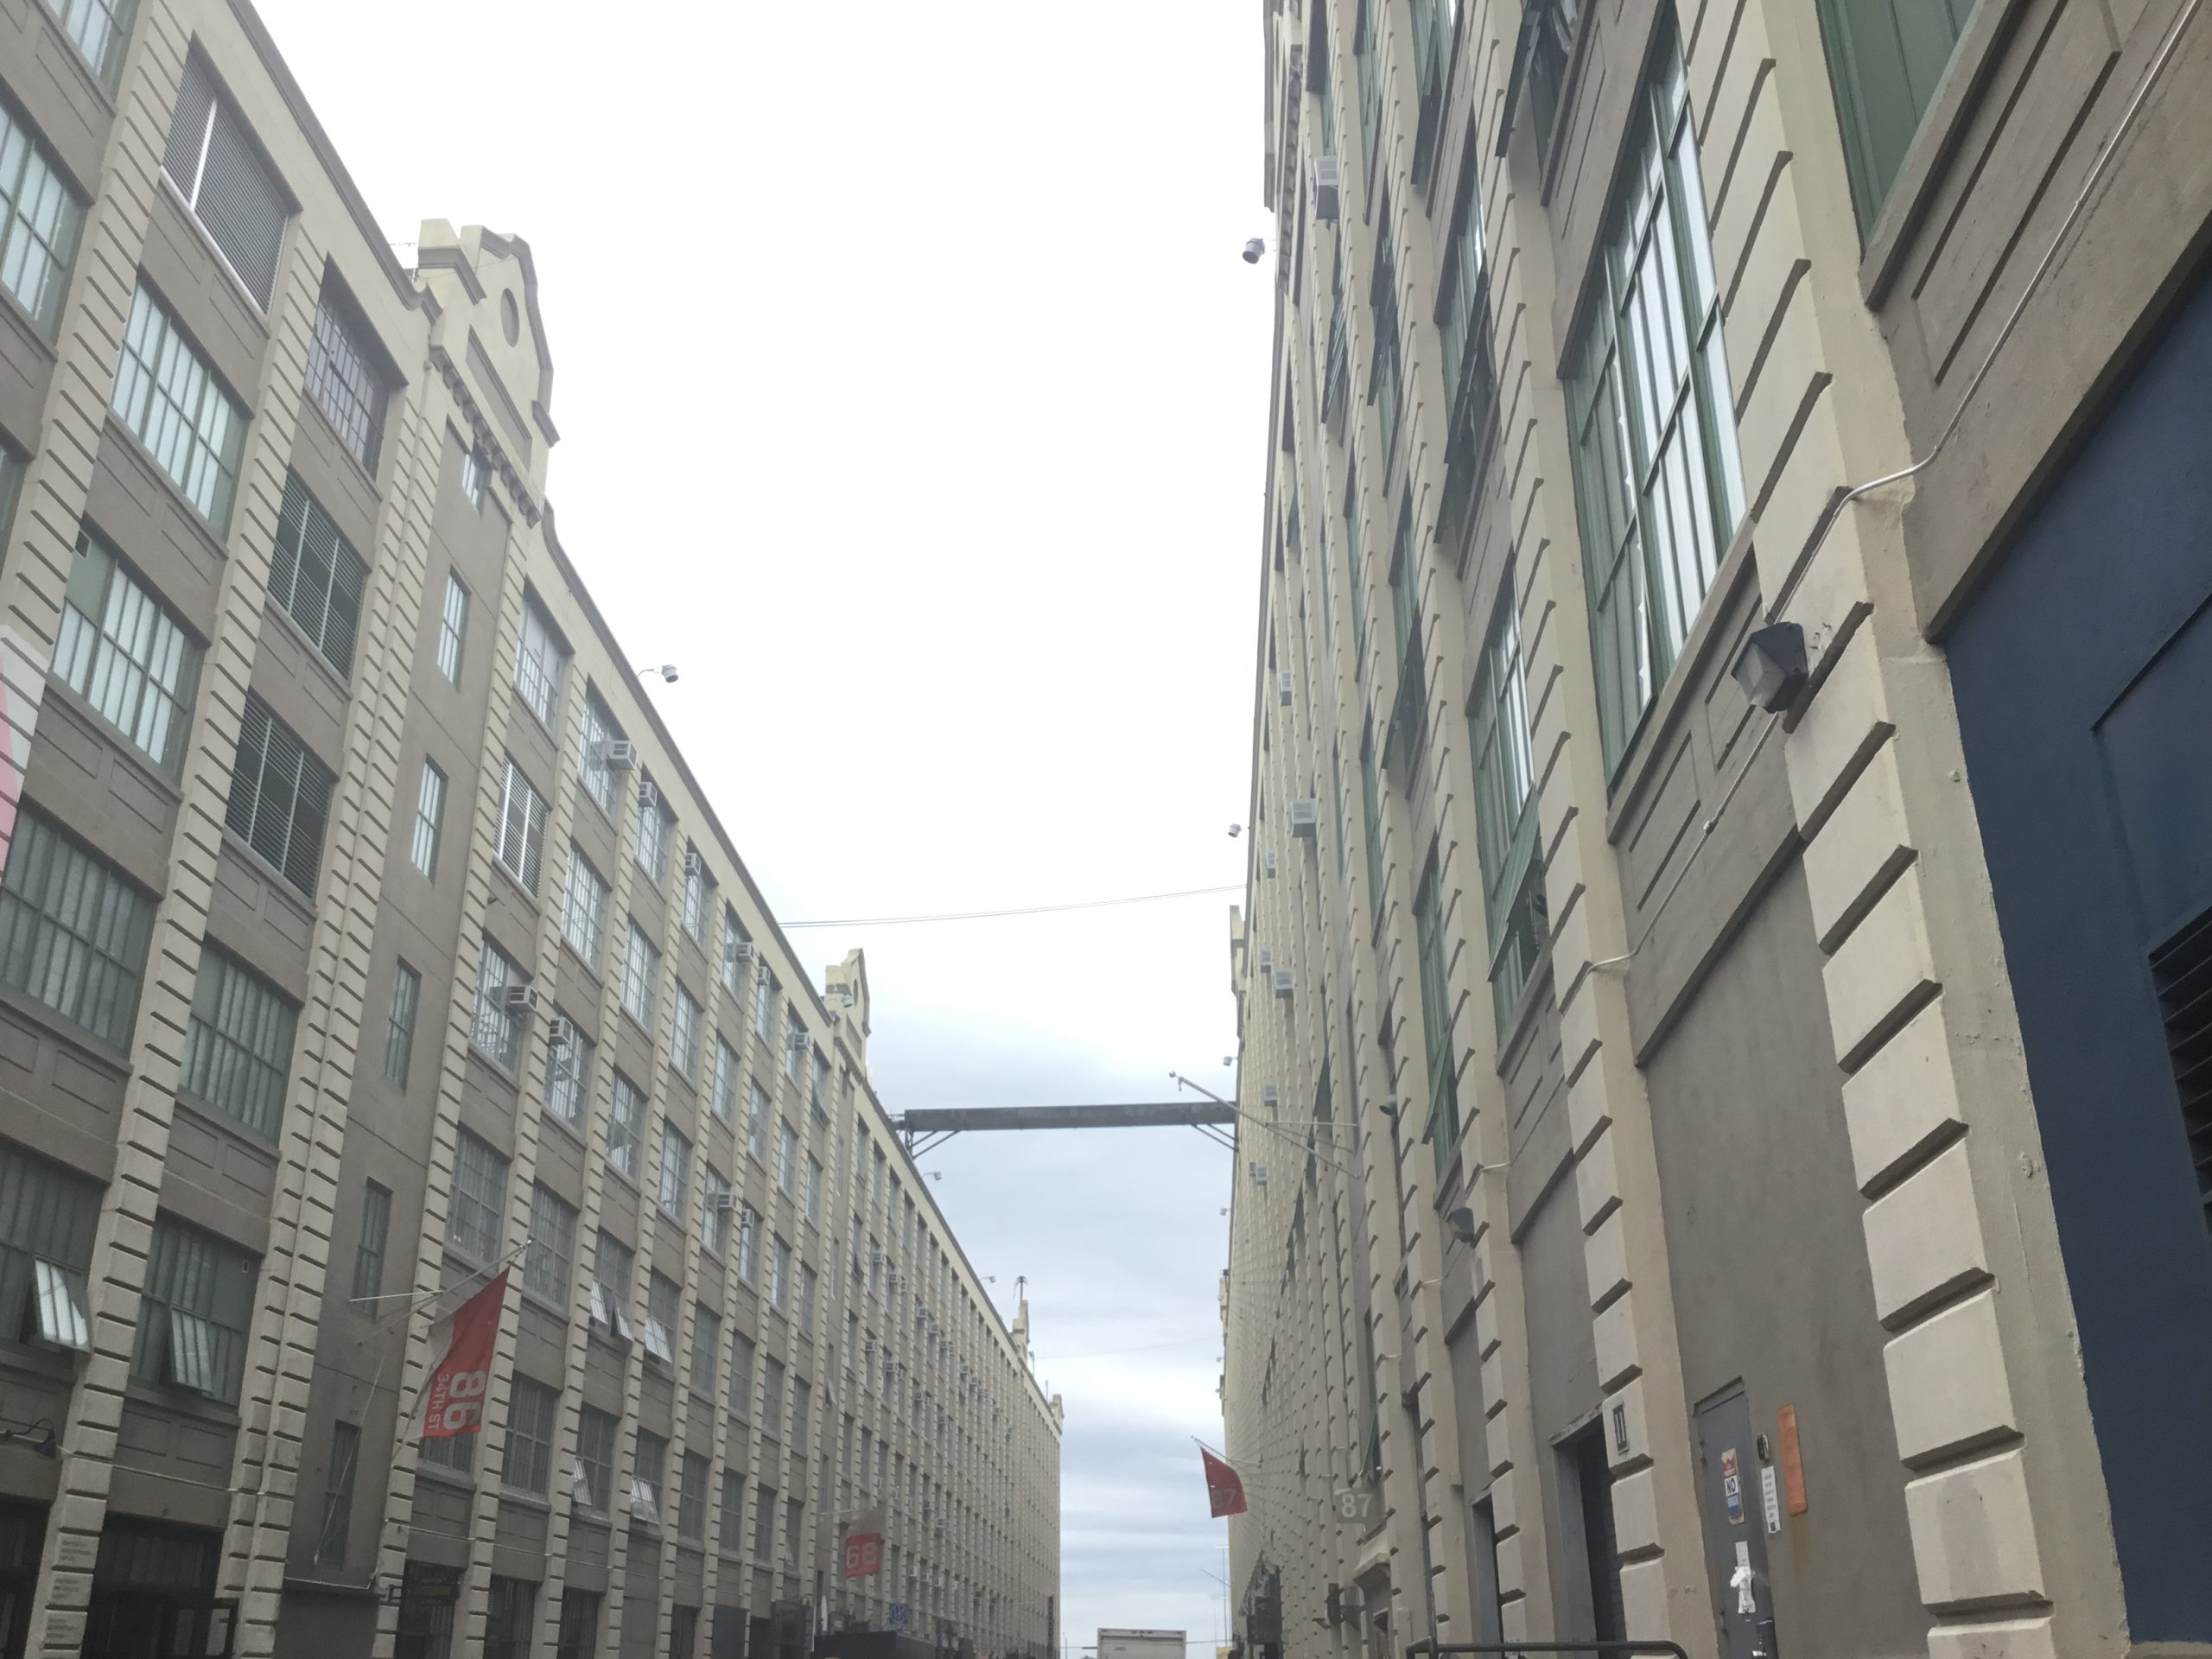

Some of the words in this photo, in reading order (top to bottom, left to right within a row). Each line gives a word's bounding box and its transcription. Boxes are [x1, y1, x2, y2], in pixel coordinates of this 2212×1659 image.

[432, 1374, 449, 1410] 34TH
[443, 1370, 486, 1430] 86
[428, 1414, 441, 1430] ST
[1726, 1478, 1736, 1494] NO
[1341, 1493, 1372, 1518] 87
[847, 1542, 878, 1569] 68
